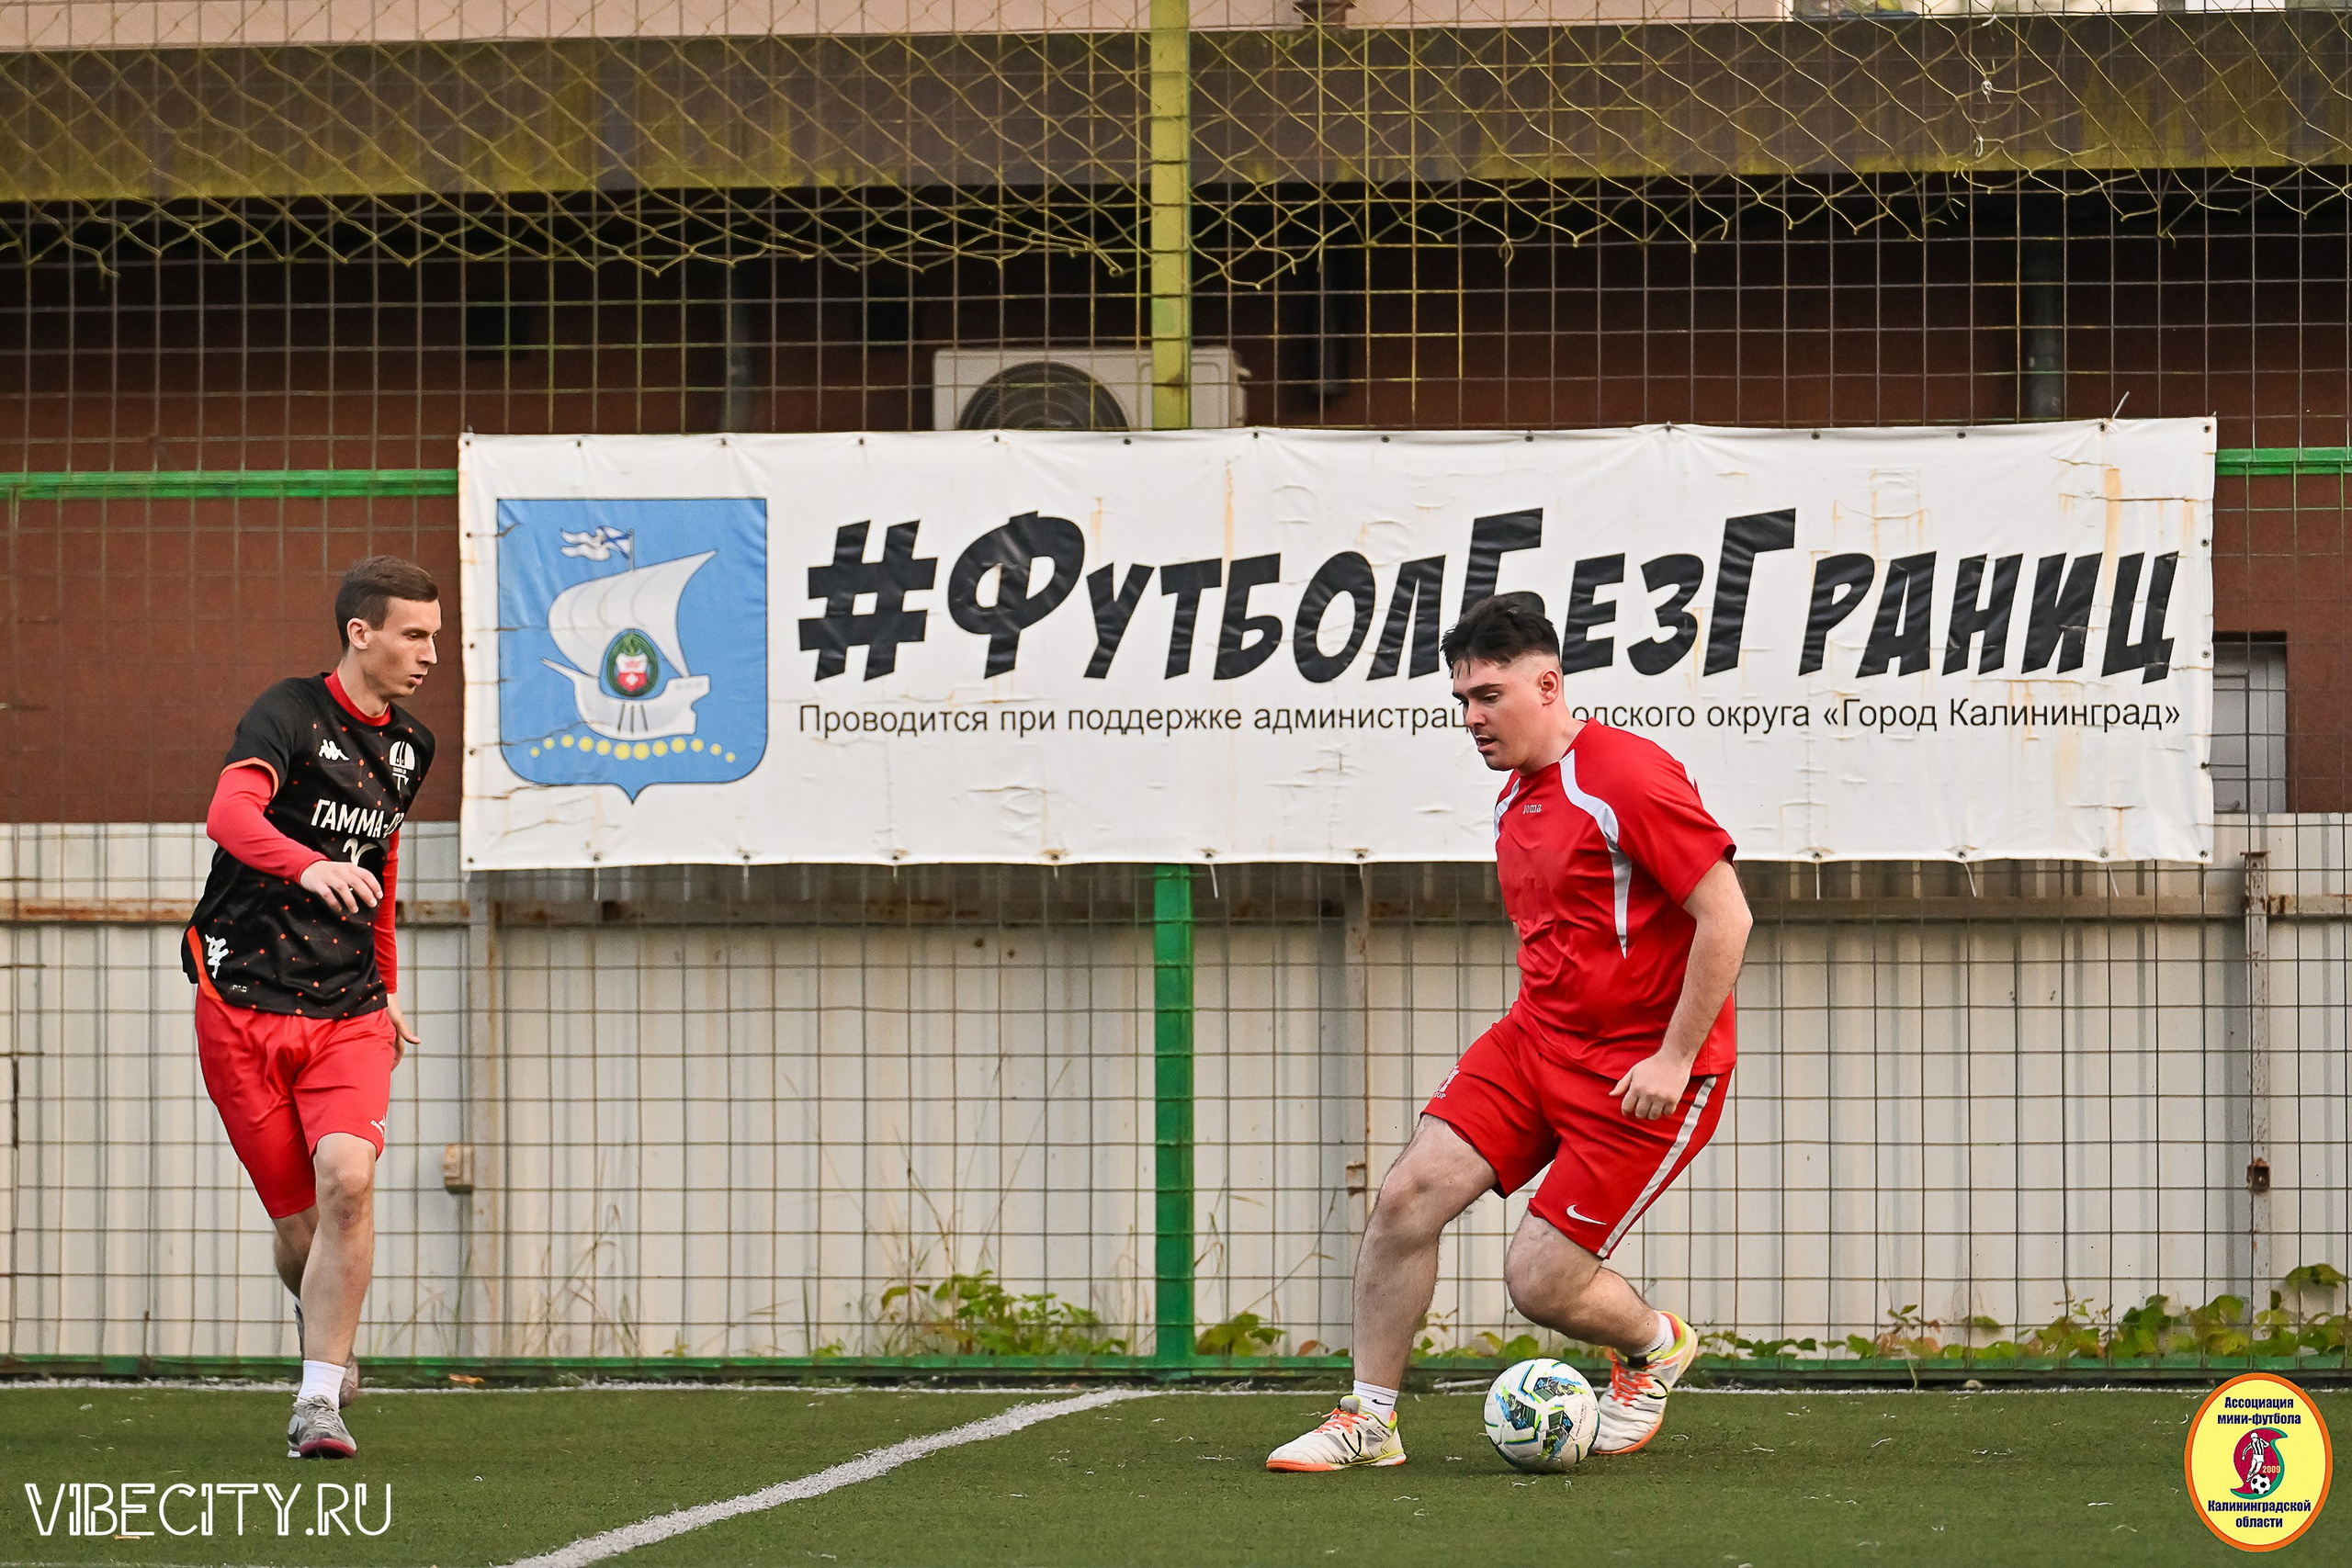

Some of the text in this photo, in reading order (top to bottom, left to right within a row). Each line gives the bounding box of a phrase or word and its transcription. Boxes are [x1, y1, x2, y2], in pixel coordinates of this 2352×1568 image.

[799, 698, 2180, 738] Проводится при поддержке администрац одского округа «Город Калининград»
